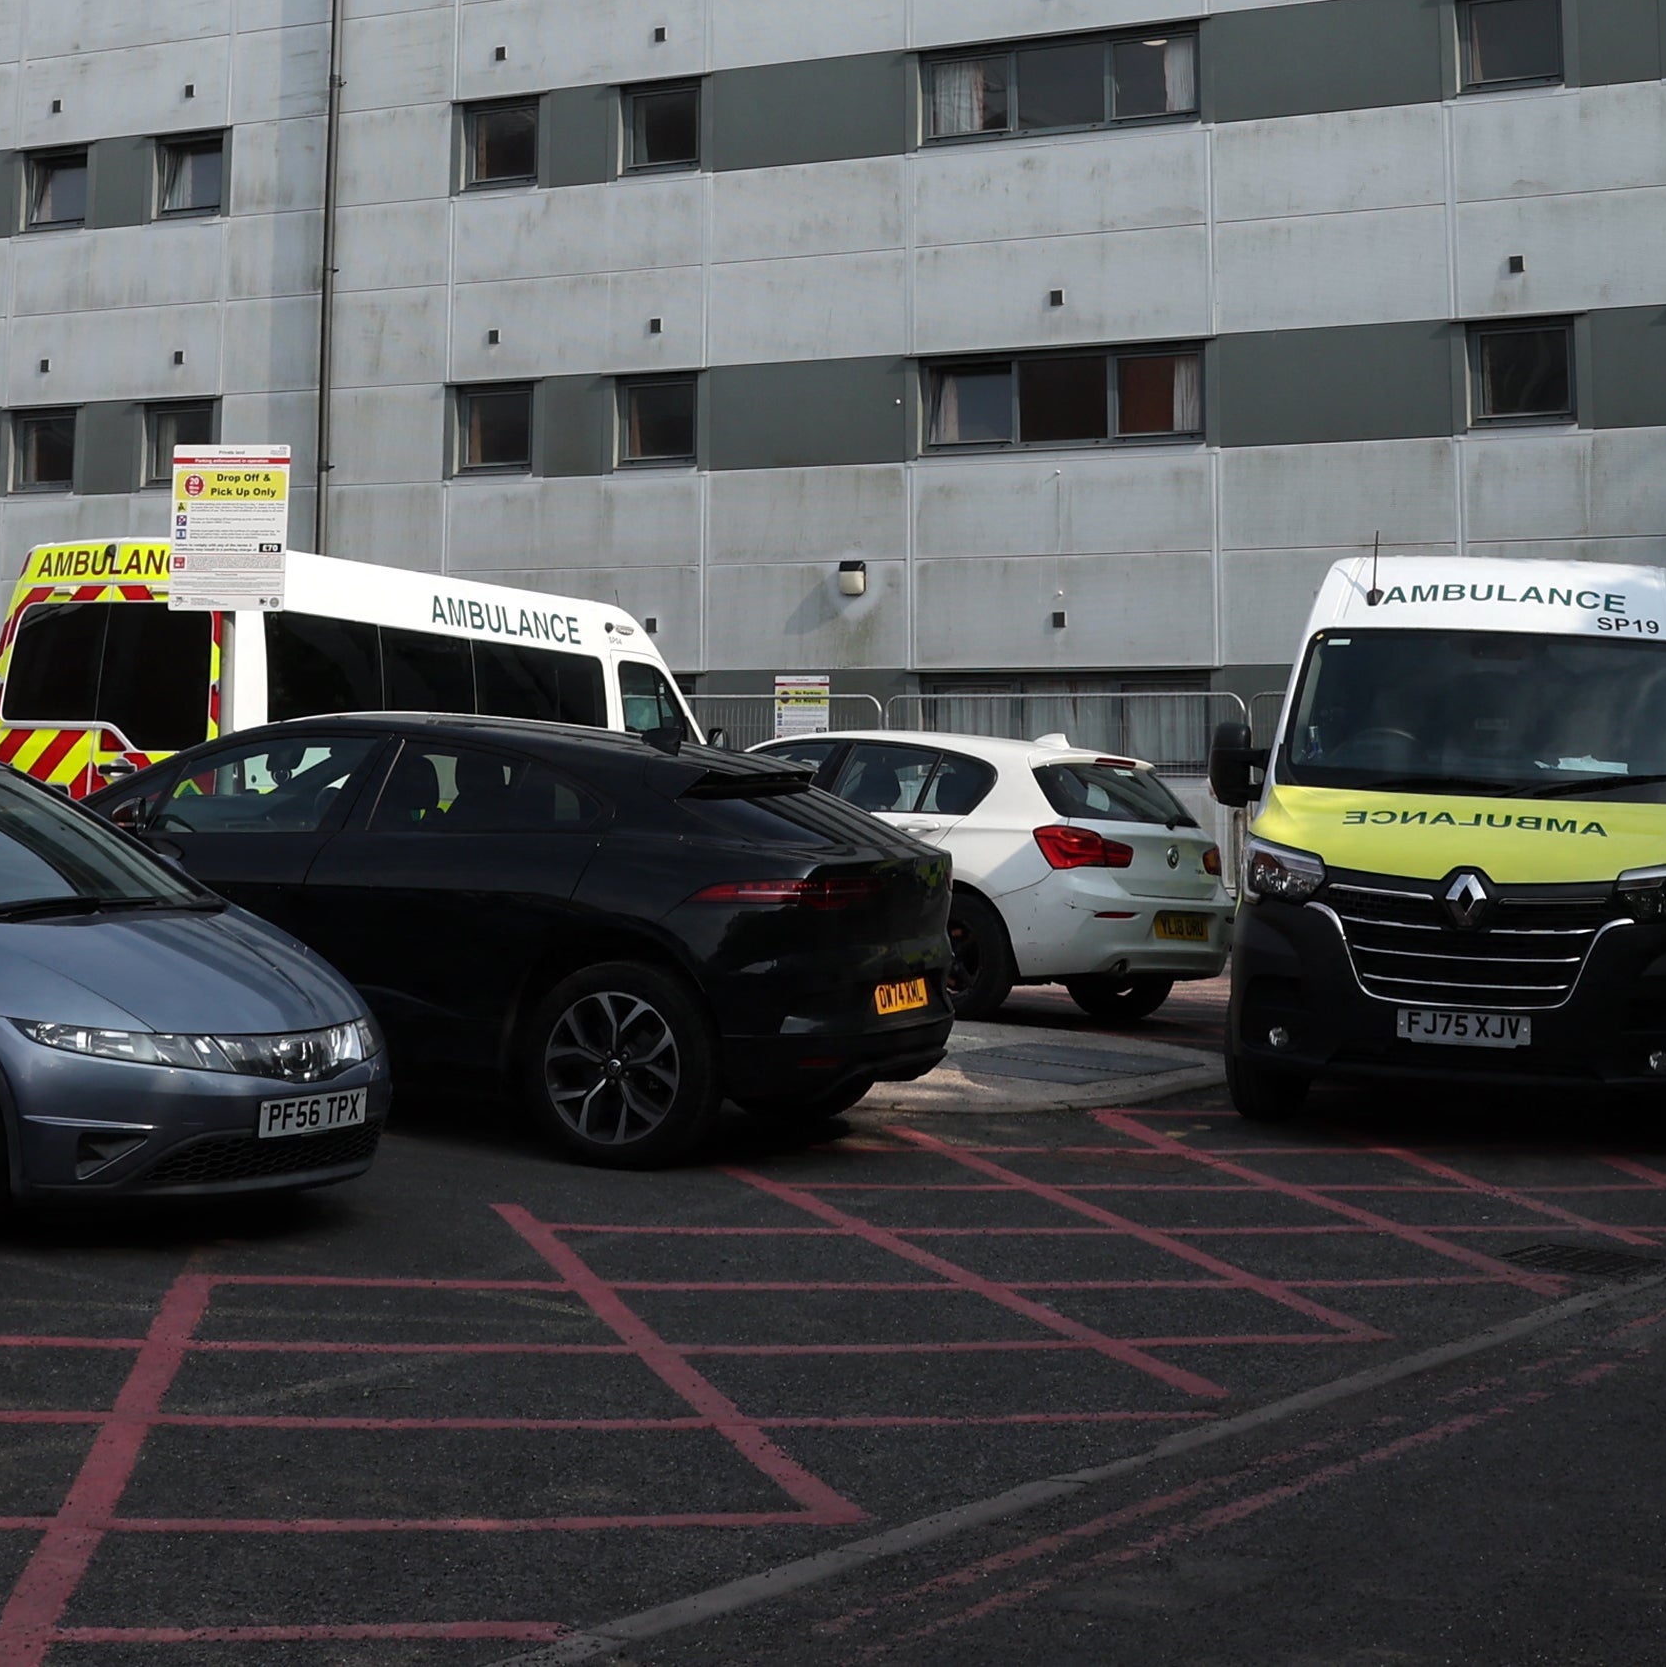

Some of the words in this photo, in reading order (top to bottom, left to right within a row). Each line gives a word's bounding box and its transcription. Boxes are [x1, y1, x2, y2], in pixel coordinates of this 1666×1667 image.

[189, 477, 199, 485] 20
[217, 474, 241, 483] Drop
[244, 474, 259, 482] Off
[263, 474, 271, 482] &
[210, 488, 233, 496] Pick
[236, 488, 250, 498] Up
[253, 488, 277, 498] Only
[37, 549, 170, 578] AMBULAN
[1383, 584, 1626, 614] AMBULANCE
[432, 595, 581, 644] AMBULANCE
[1597, 617, 1659, 634] SP19
[1407, 1012, 1468, 1036] FJ75
[1475, 1016, 1521, 1039] XJV
[267, 1099, 320, 1131] PF56
[326, 1094, 359, 1124] TPX
